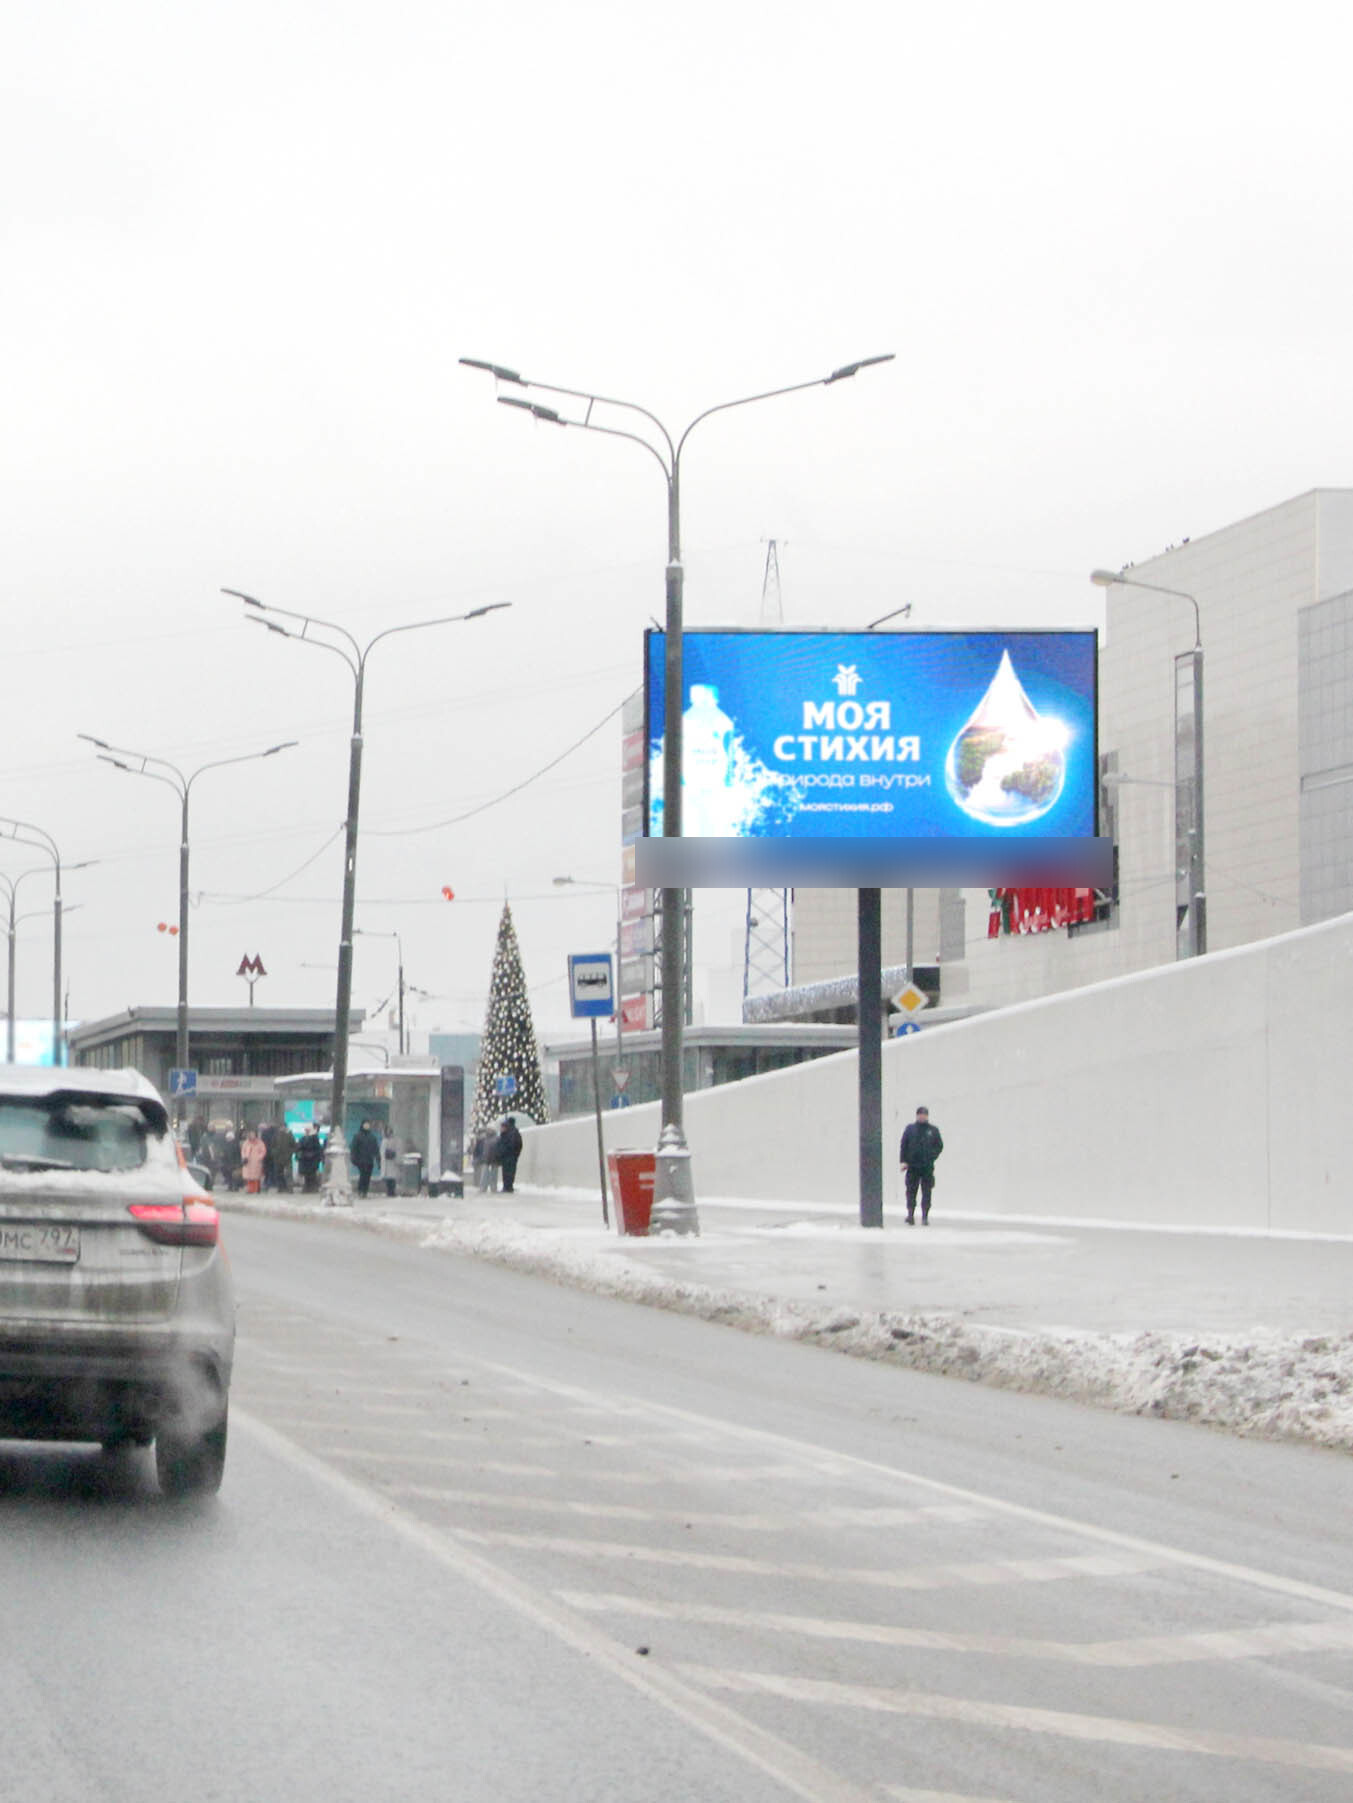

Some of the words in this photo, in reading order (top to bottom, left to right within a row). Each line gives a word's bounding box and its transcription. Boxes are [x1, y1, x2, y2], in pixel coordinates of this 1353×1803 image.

[802, 701, 891, 730] МОЯ
[773, 735, 921, 762] СТИХИЯ
[768, 773, 855, 790] рирода
[859, 774, 932, 790] внутри
